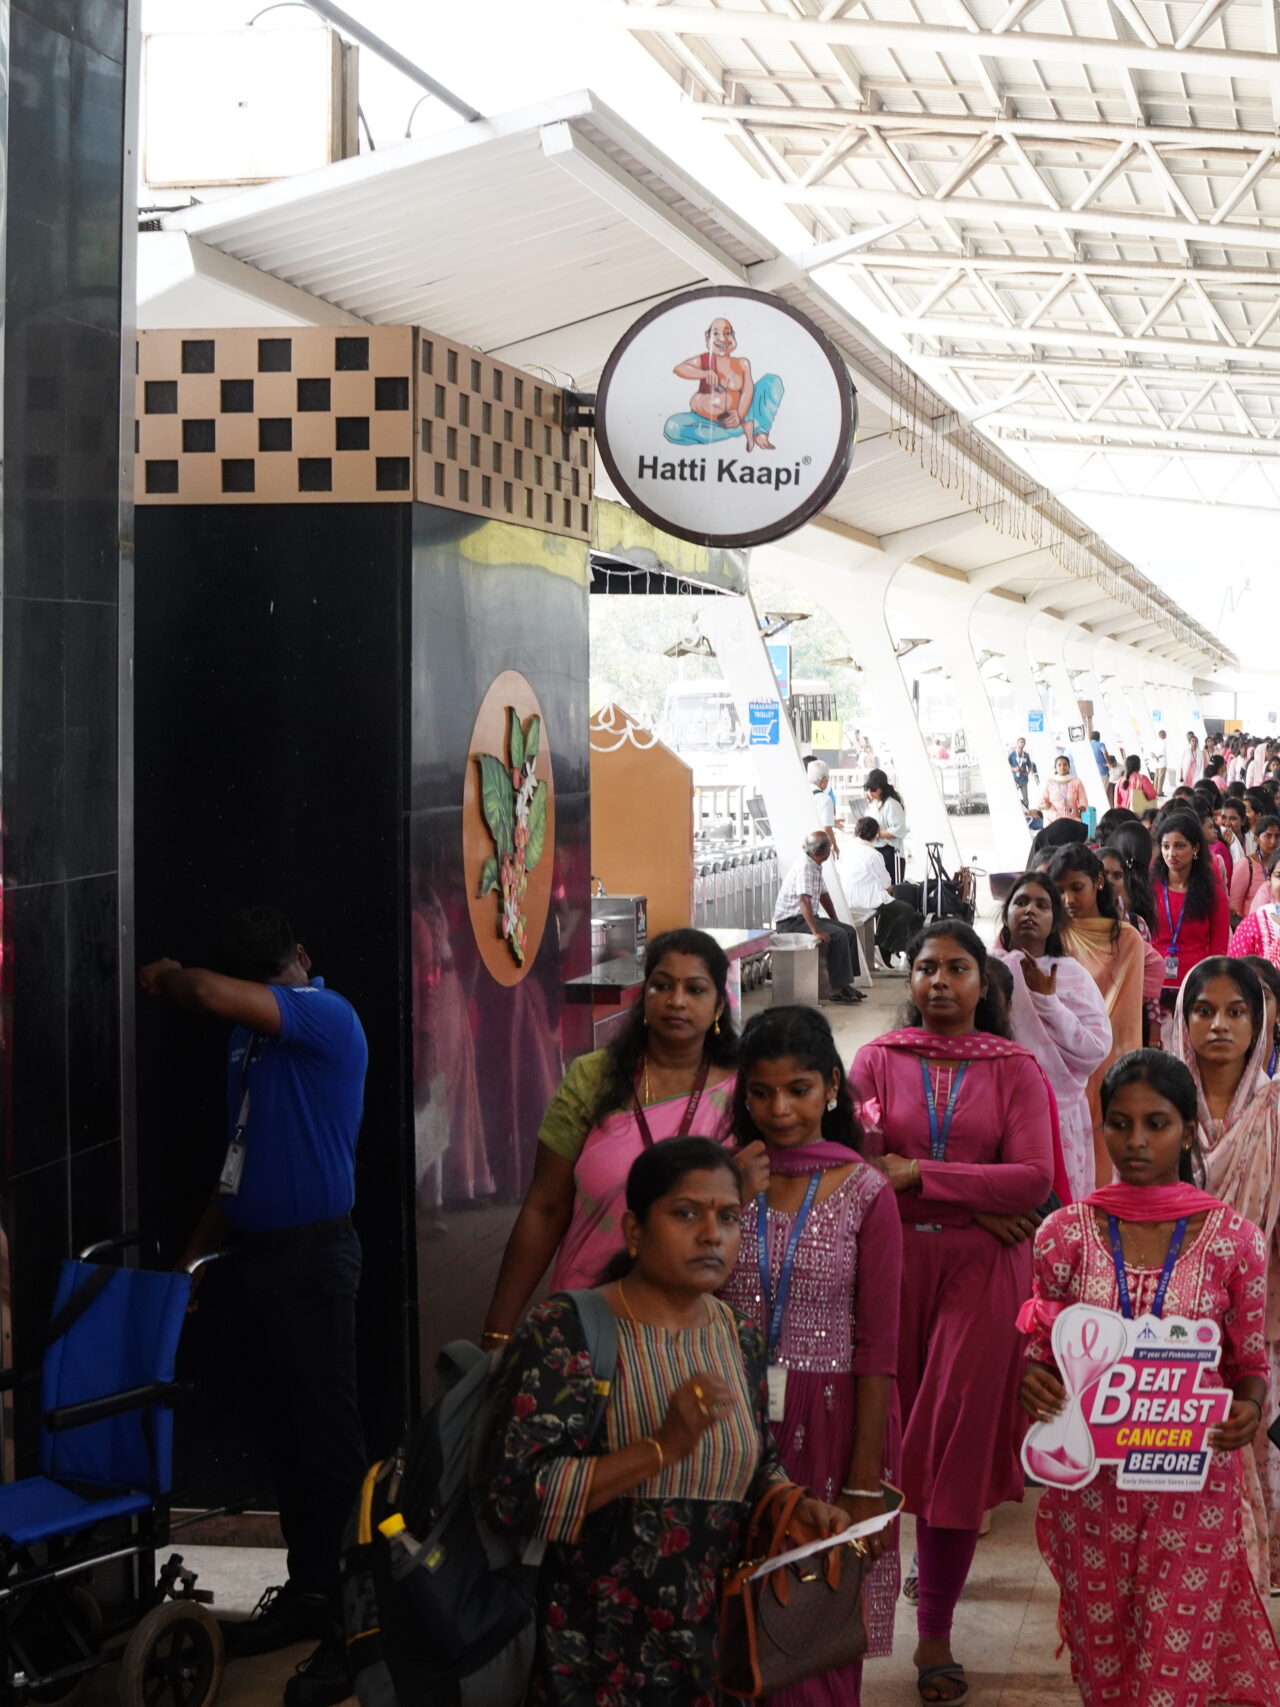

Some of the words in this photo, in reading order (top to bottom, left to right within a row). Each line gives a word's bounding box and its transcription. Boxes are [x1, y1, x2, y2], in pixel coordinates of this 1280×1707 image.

[637, 455, 706, 482] Hatti
[1116, 1428, 1193, 1447] CANCER
[1128, 1453, 1202, 1472] BEFORE
